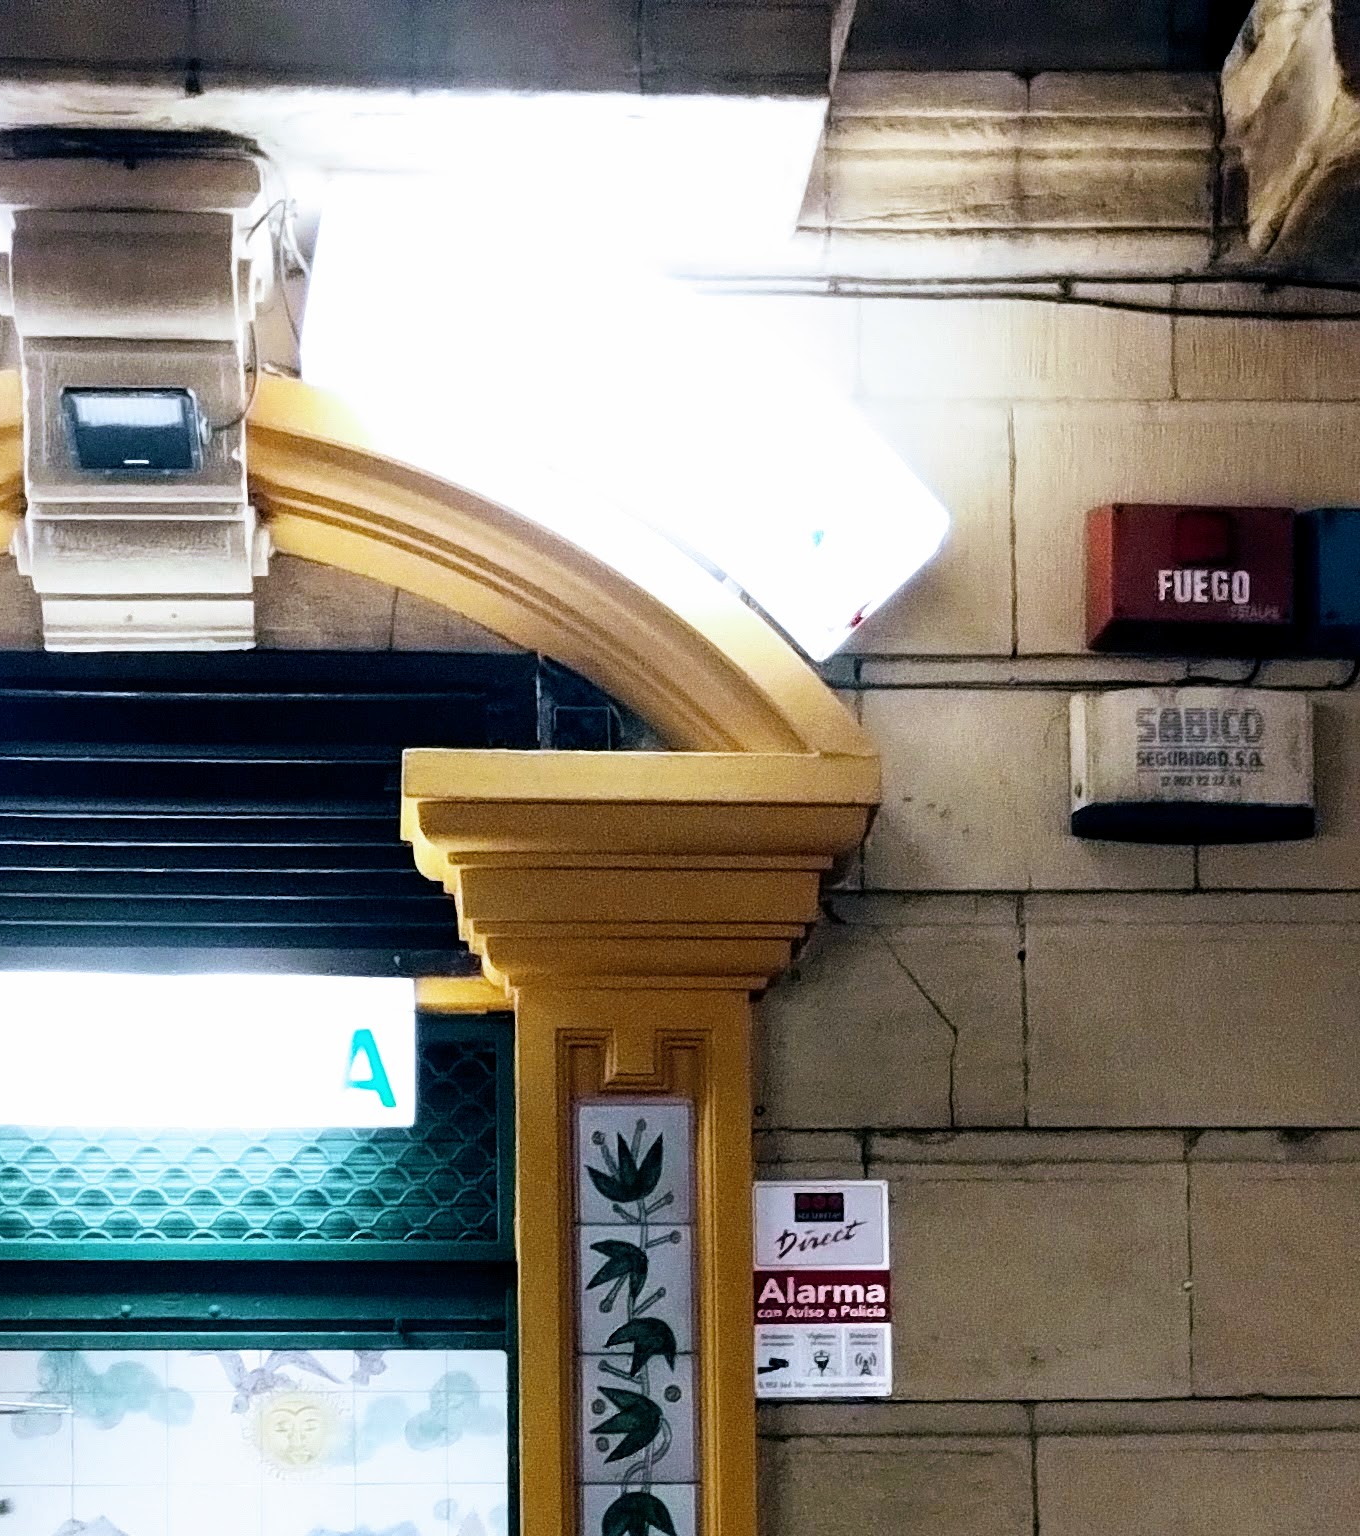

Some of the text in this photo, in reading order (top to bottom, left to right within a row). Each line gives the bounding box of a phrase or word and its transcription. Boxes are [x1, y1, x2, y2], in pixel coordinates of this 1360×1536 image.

[1157, 569, 1251, 604] FUEGO
[1135, 707, 1266, 743] SABICO
[774, 1218, 869, 1261] Direct
[757, 1277, 887, 1304] Alarma
[756, 1308, 782, 1318] con
[785, 1305, 826, 1319] Aviso
